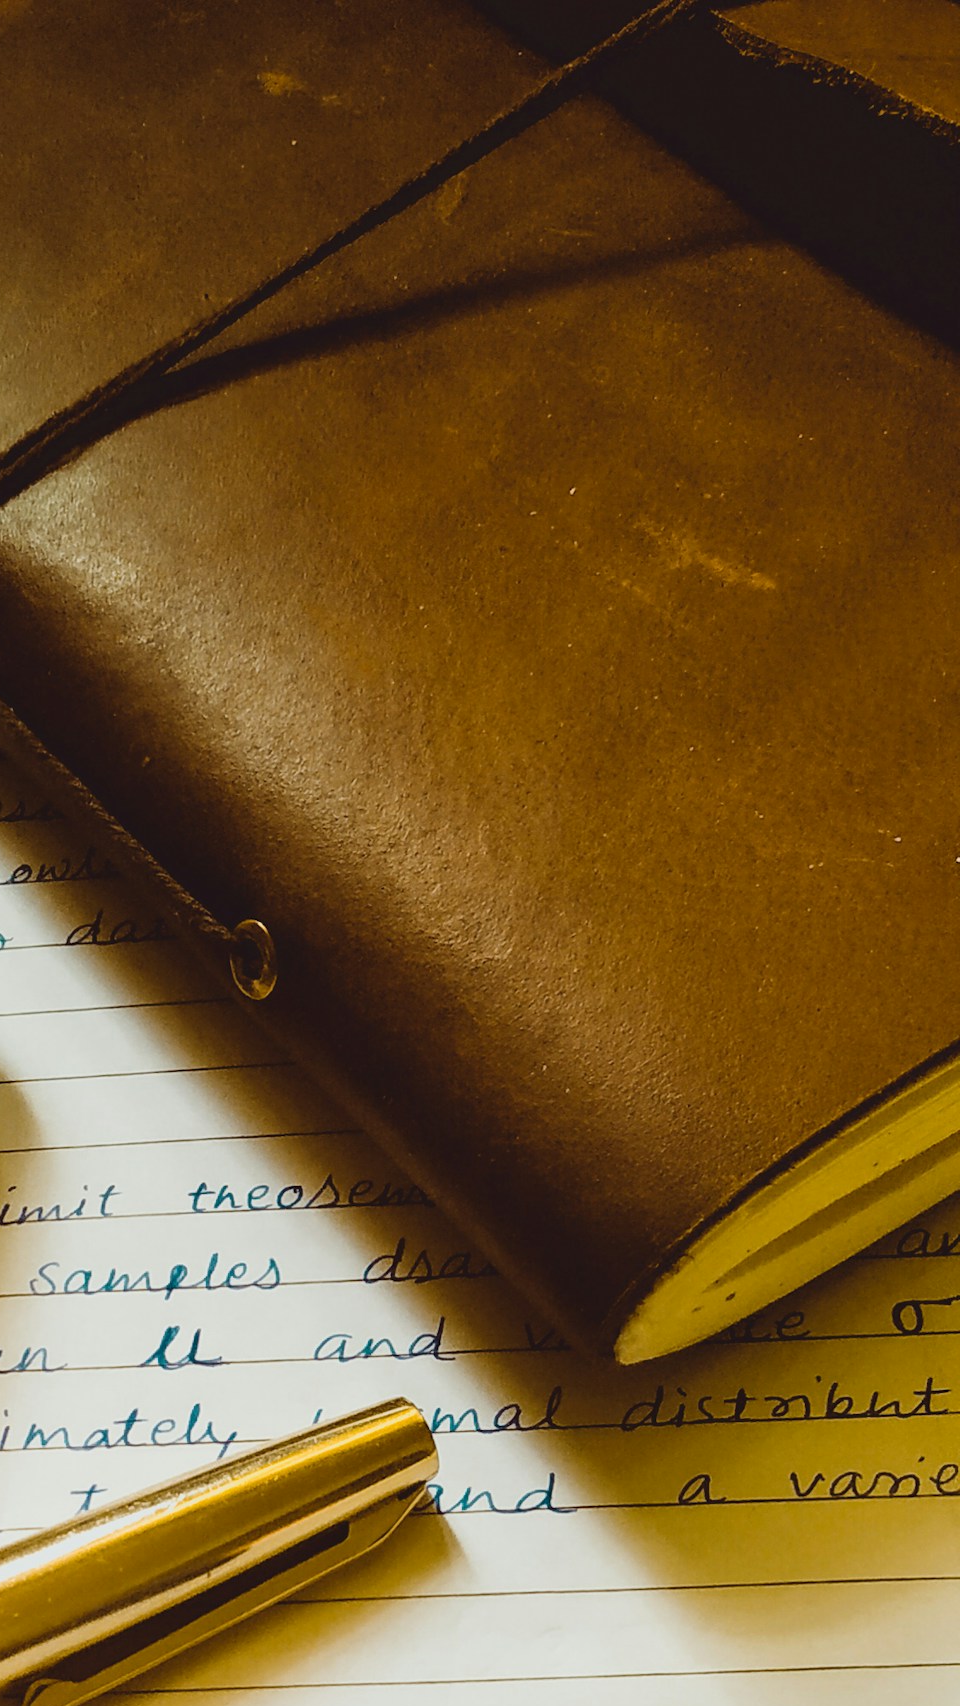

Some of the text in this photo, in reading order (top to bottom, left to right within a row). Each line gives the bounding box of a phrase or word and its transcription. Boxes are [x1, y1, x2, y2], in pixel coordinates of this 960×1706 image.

[313, 1317, 456, 1363] and
[620, 1374, 960, 1433] distribut
[677, 1472, 727, 1506] a
